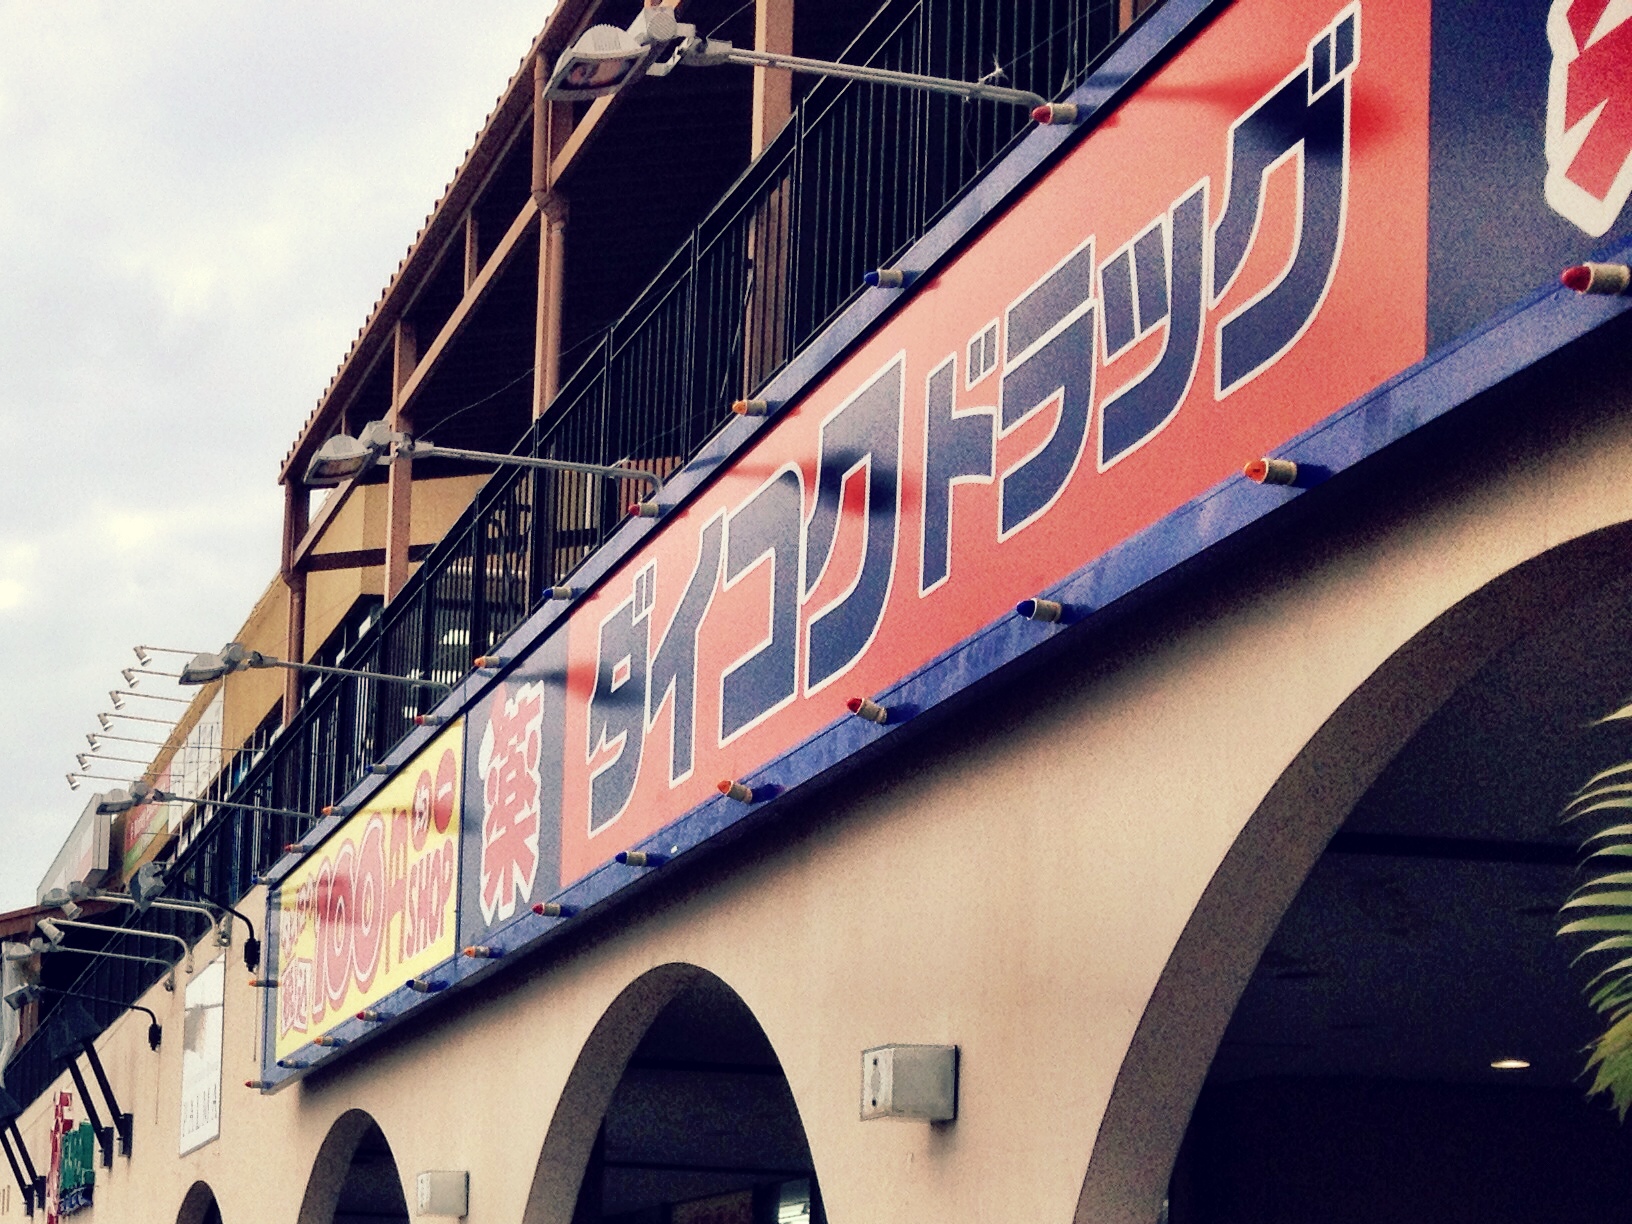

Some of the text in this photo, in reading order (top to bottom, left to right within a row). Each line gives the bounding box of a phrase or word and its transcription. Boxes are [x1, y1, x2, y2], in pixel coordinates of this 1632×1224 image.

[586, 1, 1359, 837] ダイコクドラッグ
[405, 839, 454, 959] SHOP
[480, 682, 544, 926] 薬
